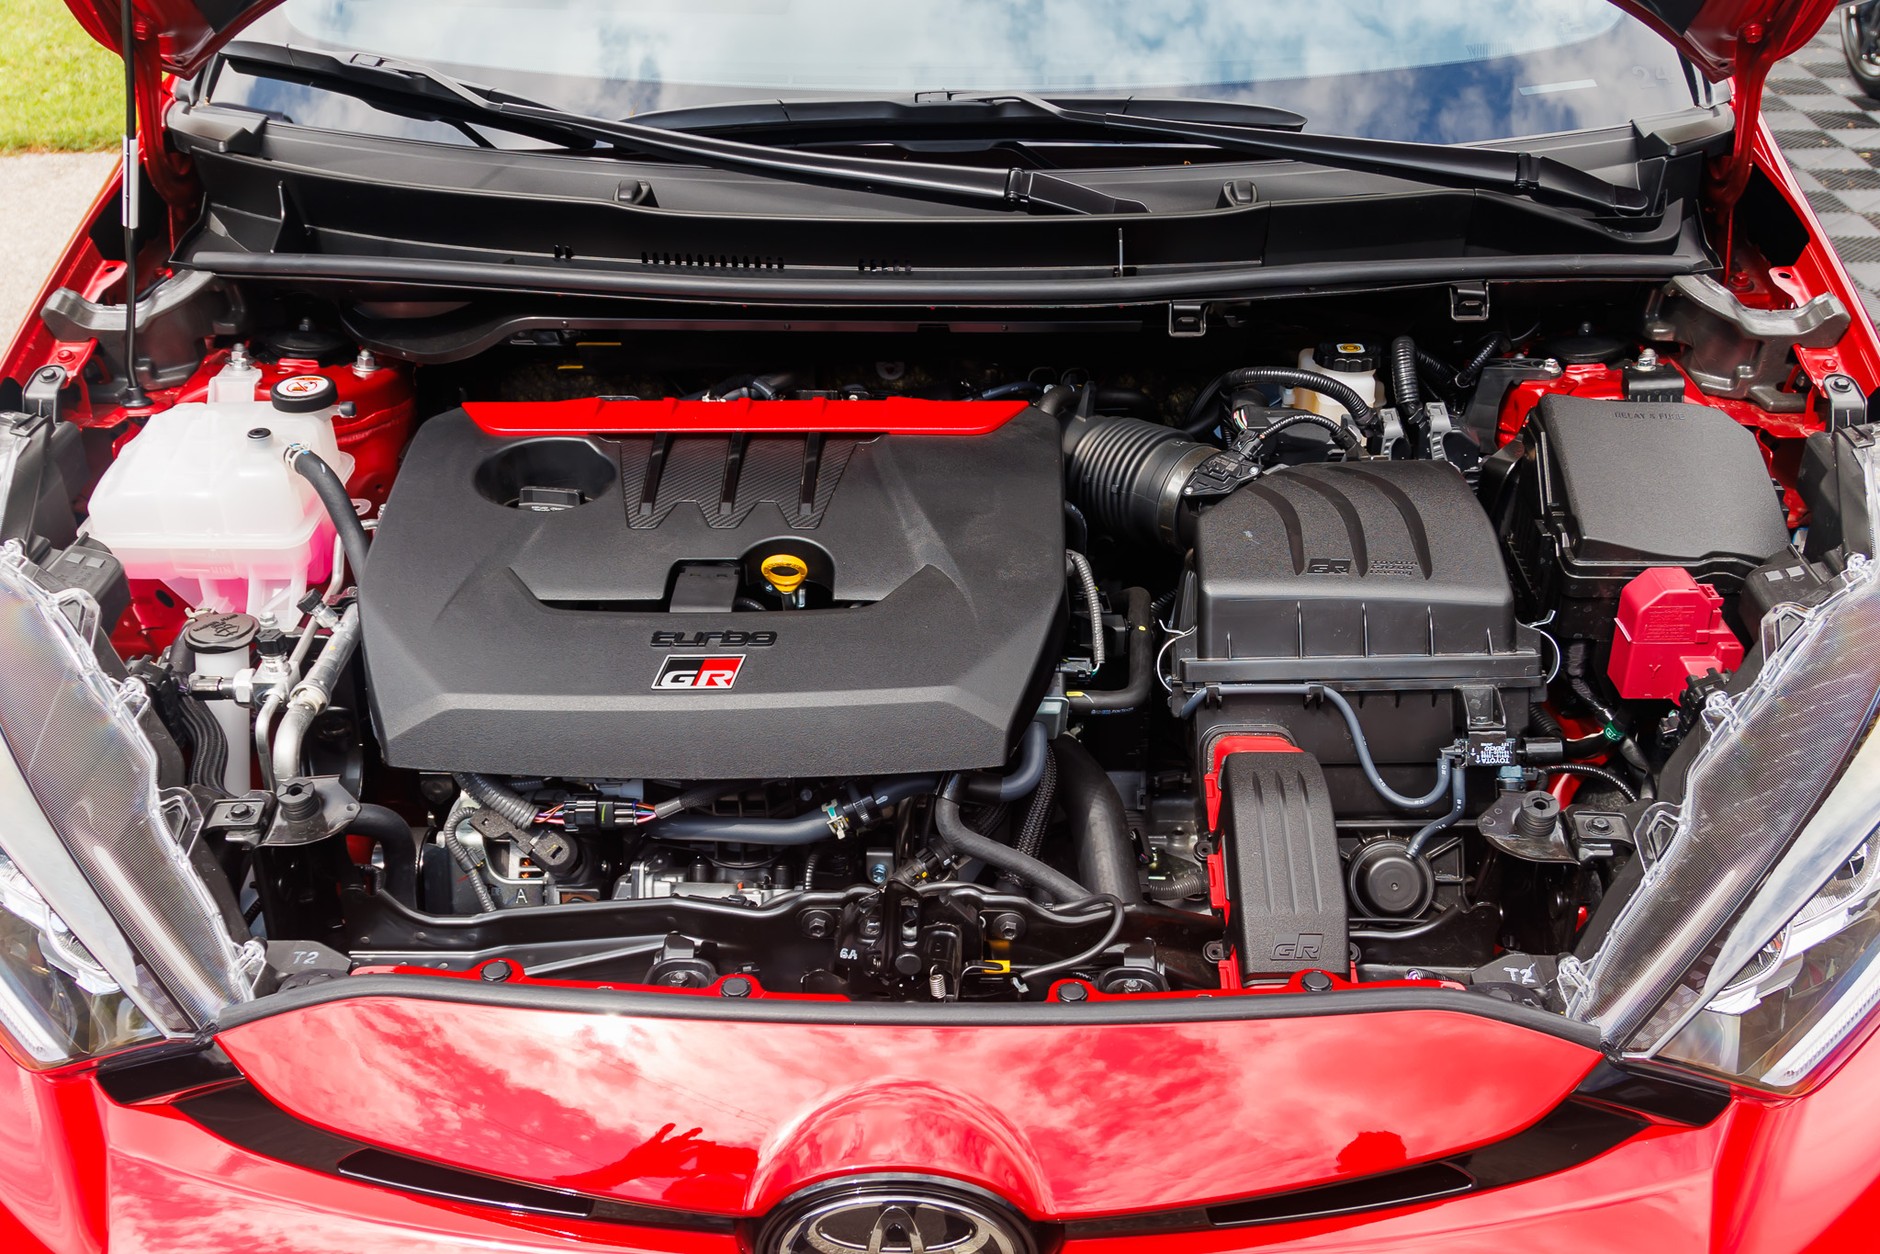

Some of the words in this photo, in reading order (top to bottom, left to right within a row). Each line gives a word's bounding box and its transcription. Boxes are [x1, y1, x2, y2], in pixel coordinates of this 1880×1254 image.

[660, 669, 735, 688] GR
[515, 888, 528, 904] A
[292, 951, 320, 965] T2
